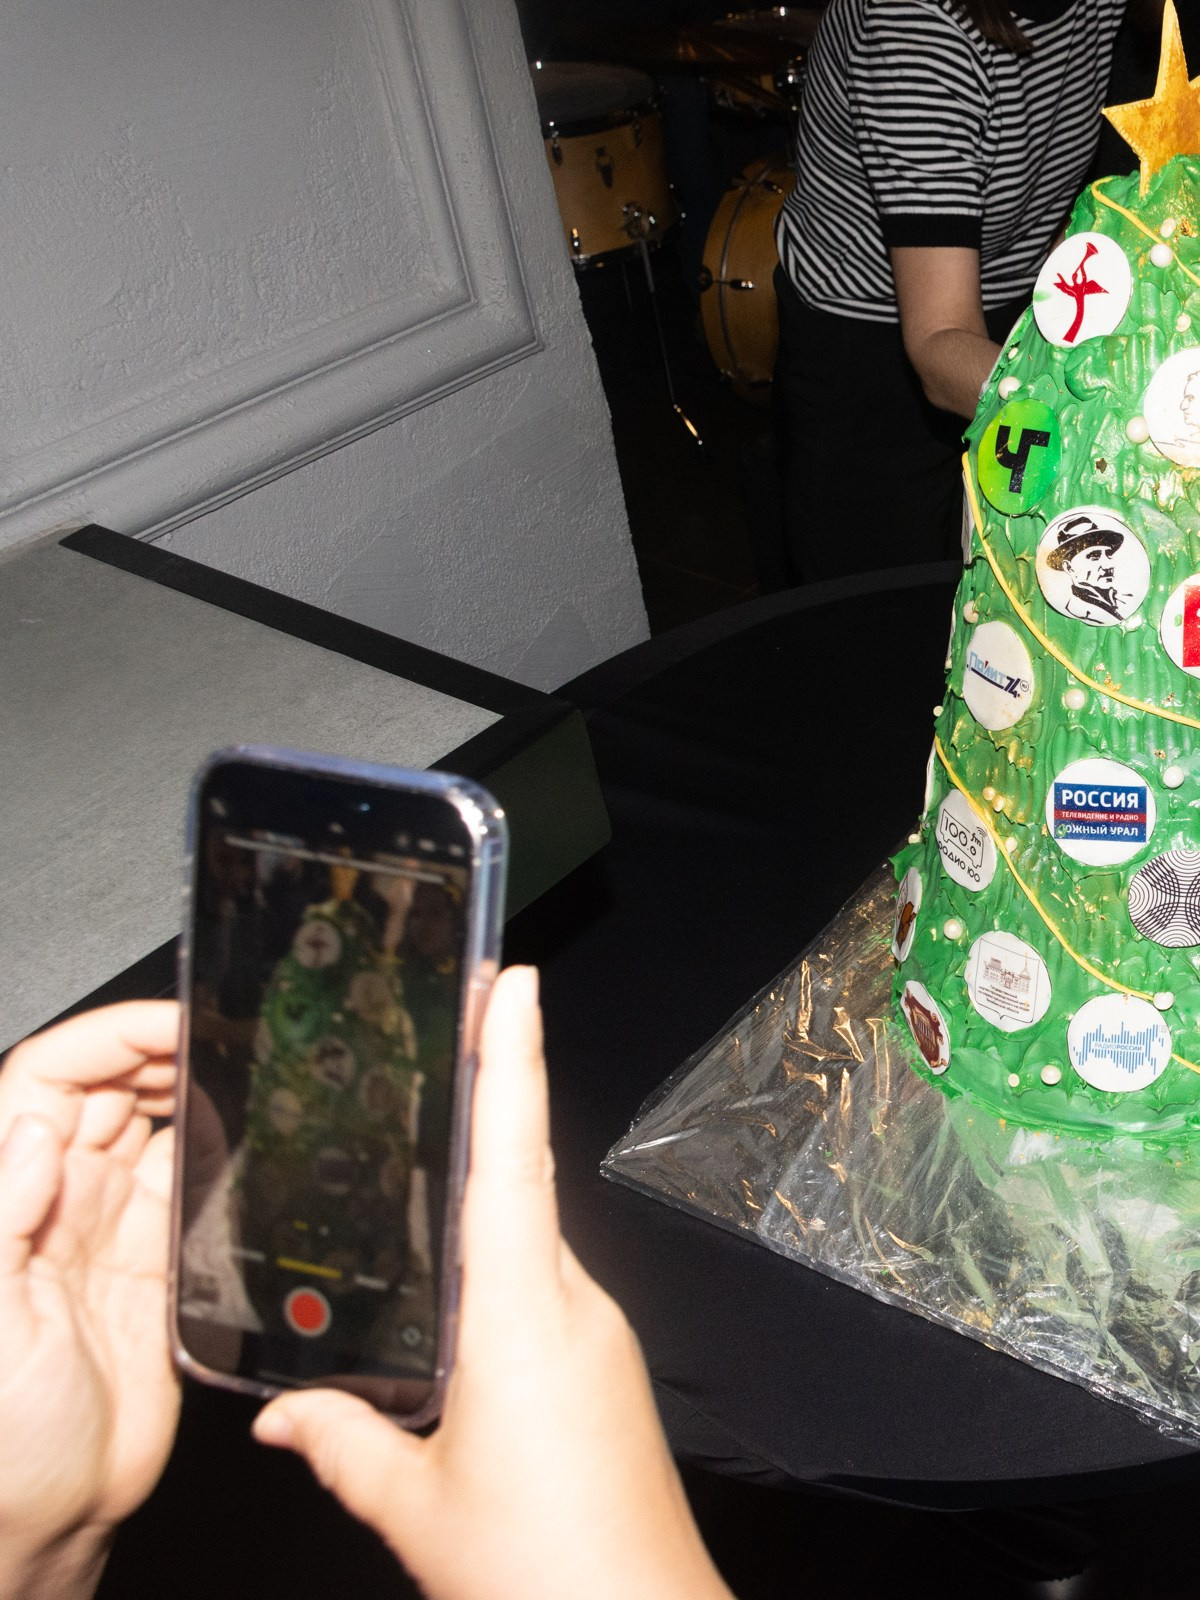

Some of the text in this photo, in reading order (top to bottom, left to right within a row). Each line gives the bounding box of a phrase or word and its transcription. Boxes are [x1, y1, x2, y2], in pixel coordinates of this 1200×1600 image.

[1061, 789, 1139, 809] РОССИЯ
[1061, 811, 1108, 820] ТЕЛЕВИДЕНИЕ
[1110, 826, 1139, 837] УРАЛ
